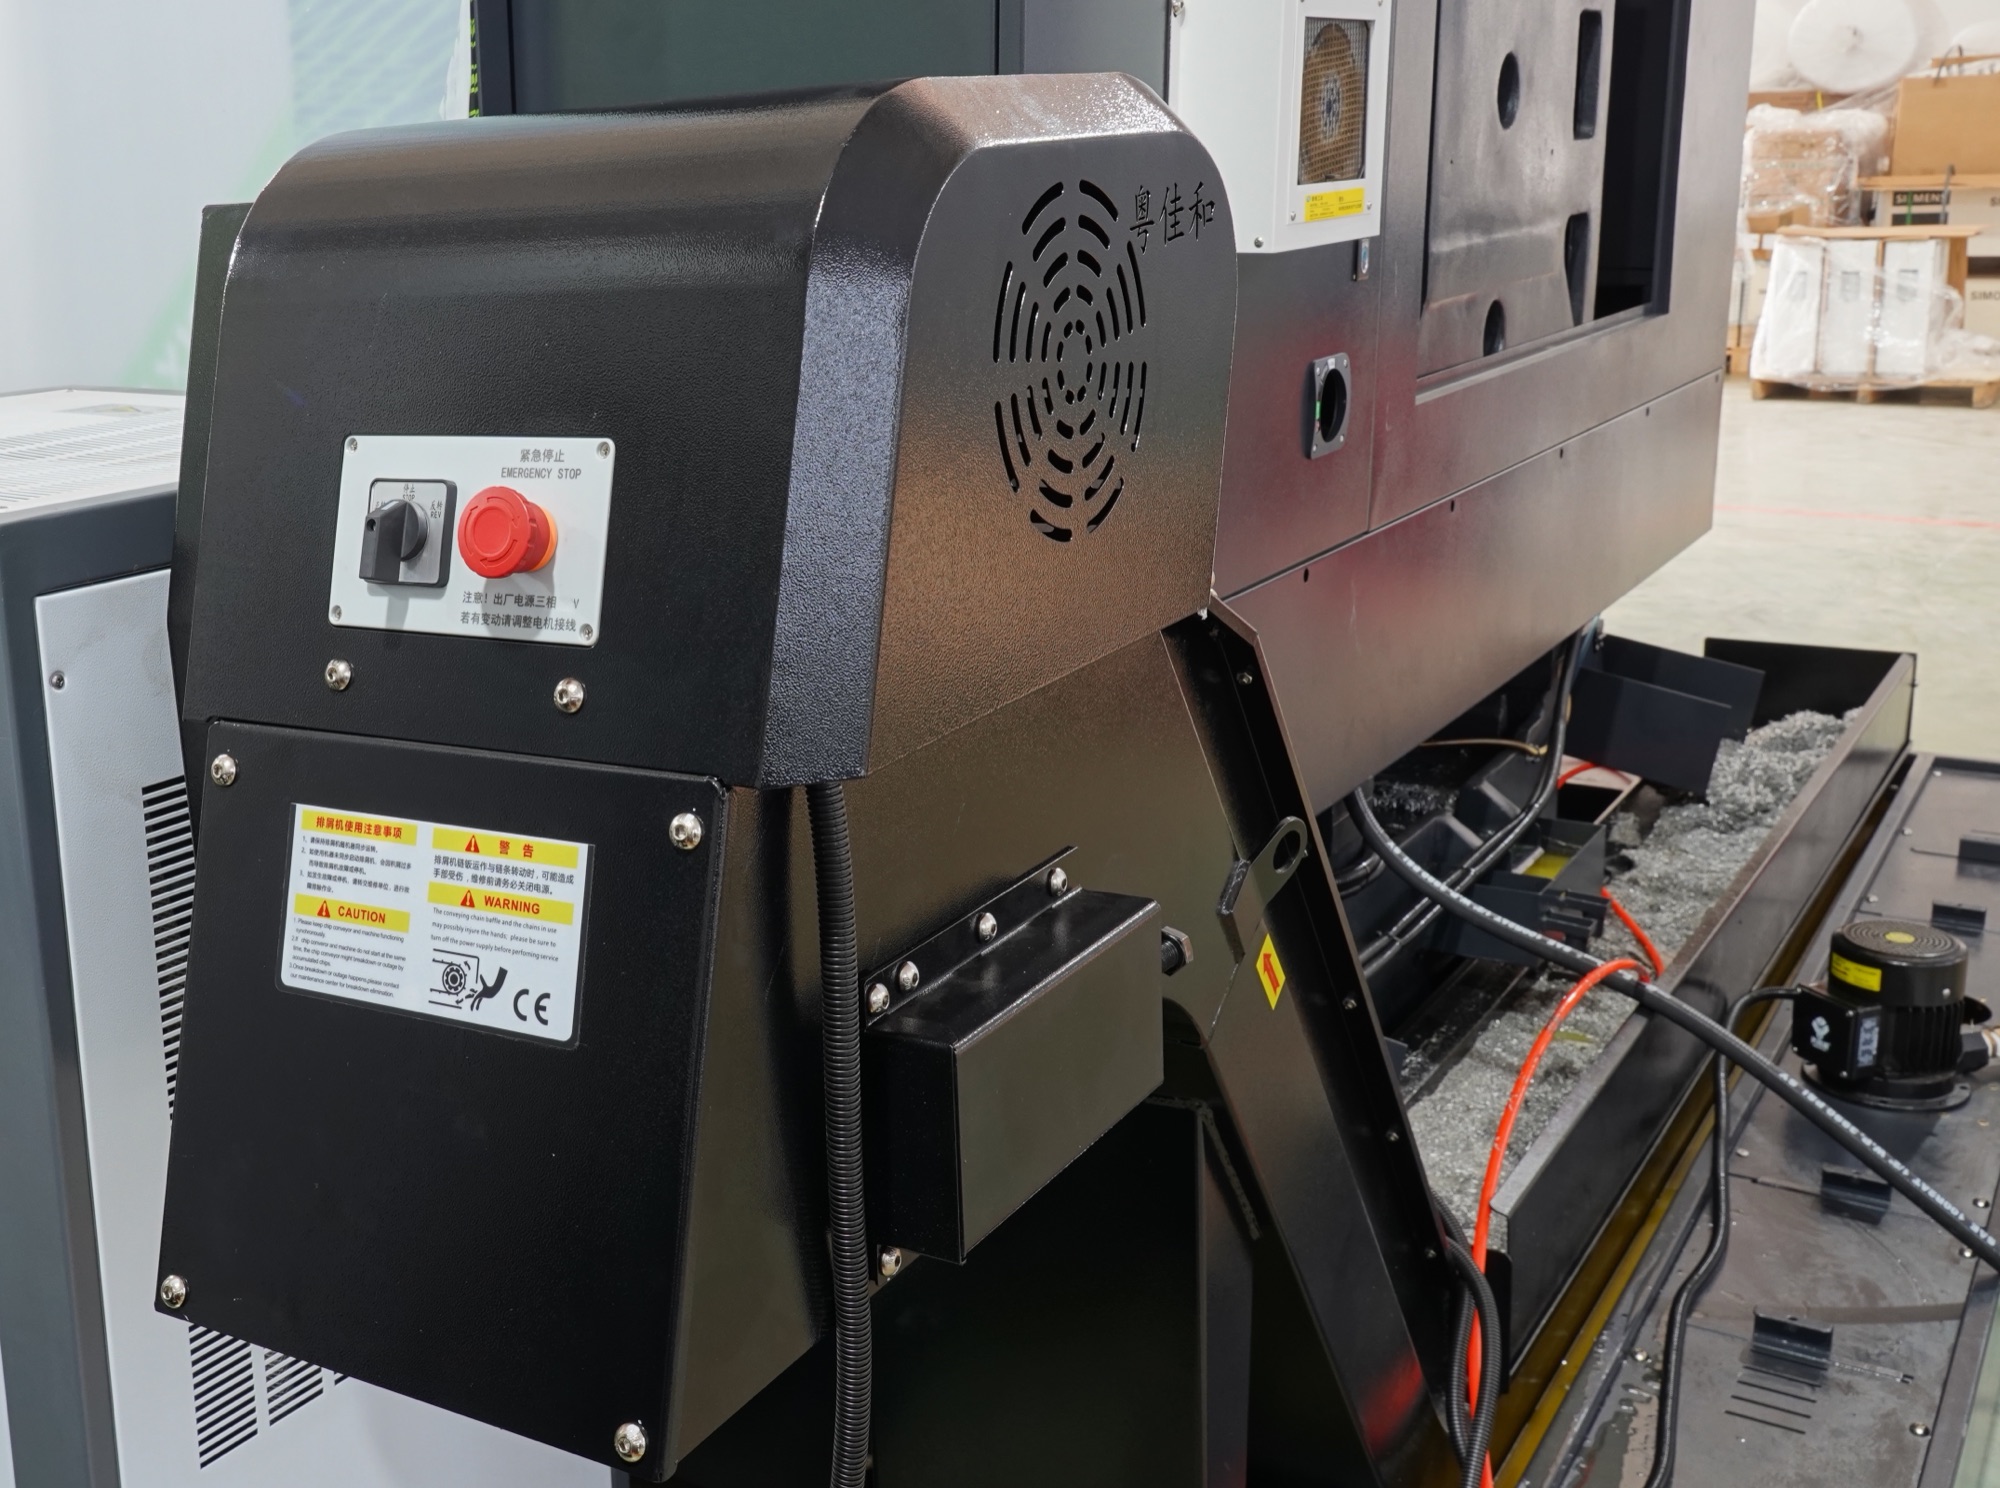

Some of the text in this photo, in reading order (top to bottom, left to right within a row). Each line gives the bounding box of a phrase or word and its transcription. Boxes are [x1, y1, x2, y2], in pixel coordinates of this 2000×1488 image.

[1895, 192, 1947, 204] SIMEN
[520, 449, 565, 463] 紧急停止
[501, 467, 582, 480] EMERGENCY STOP
[431, 511, 442, 519] REV
[573, 598, 580, 609] V
[460, 611, 577, 632] 若有变动请调整电机接线
[315, 815, 402, 839] 排屑机使用注意事项
[484, 895, 540, 914] WARNING
[337, 905, 385, 923] CAUTION
[443, 910, 469, 920] conveying
[470, 913, 484, 921] chain
[485, 916, 500, 924] baffle
[502, 918, 512, 926] and
[522, 922, 540, 930] chains
[332, 924, 351, 933] conveyor
[361, 929, 379, 937] machine
[379, 932, 404, 943] functioning
[431, 921, 442, 929] may
[443, 922, 463, 933] possibly
[480, 928, 489, 936] the
[510, 933, 527, 943] please
[320, 950, 339, 959] conveyor
[338, 944, 355, 952] machine
[459, 940, 474, 948] power
[475, 942, 492, 951] supply
[494, 944, 511, 953] before
[540, 952, 558, 961] service
[1970, 1222, 1996, 1247] SAE
